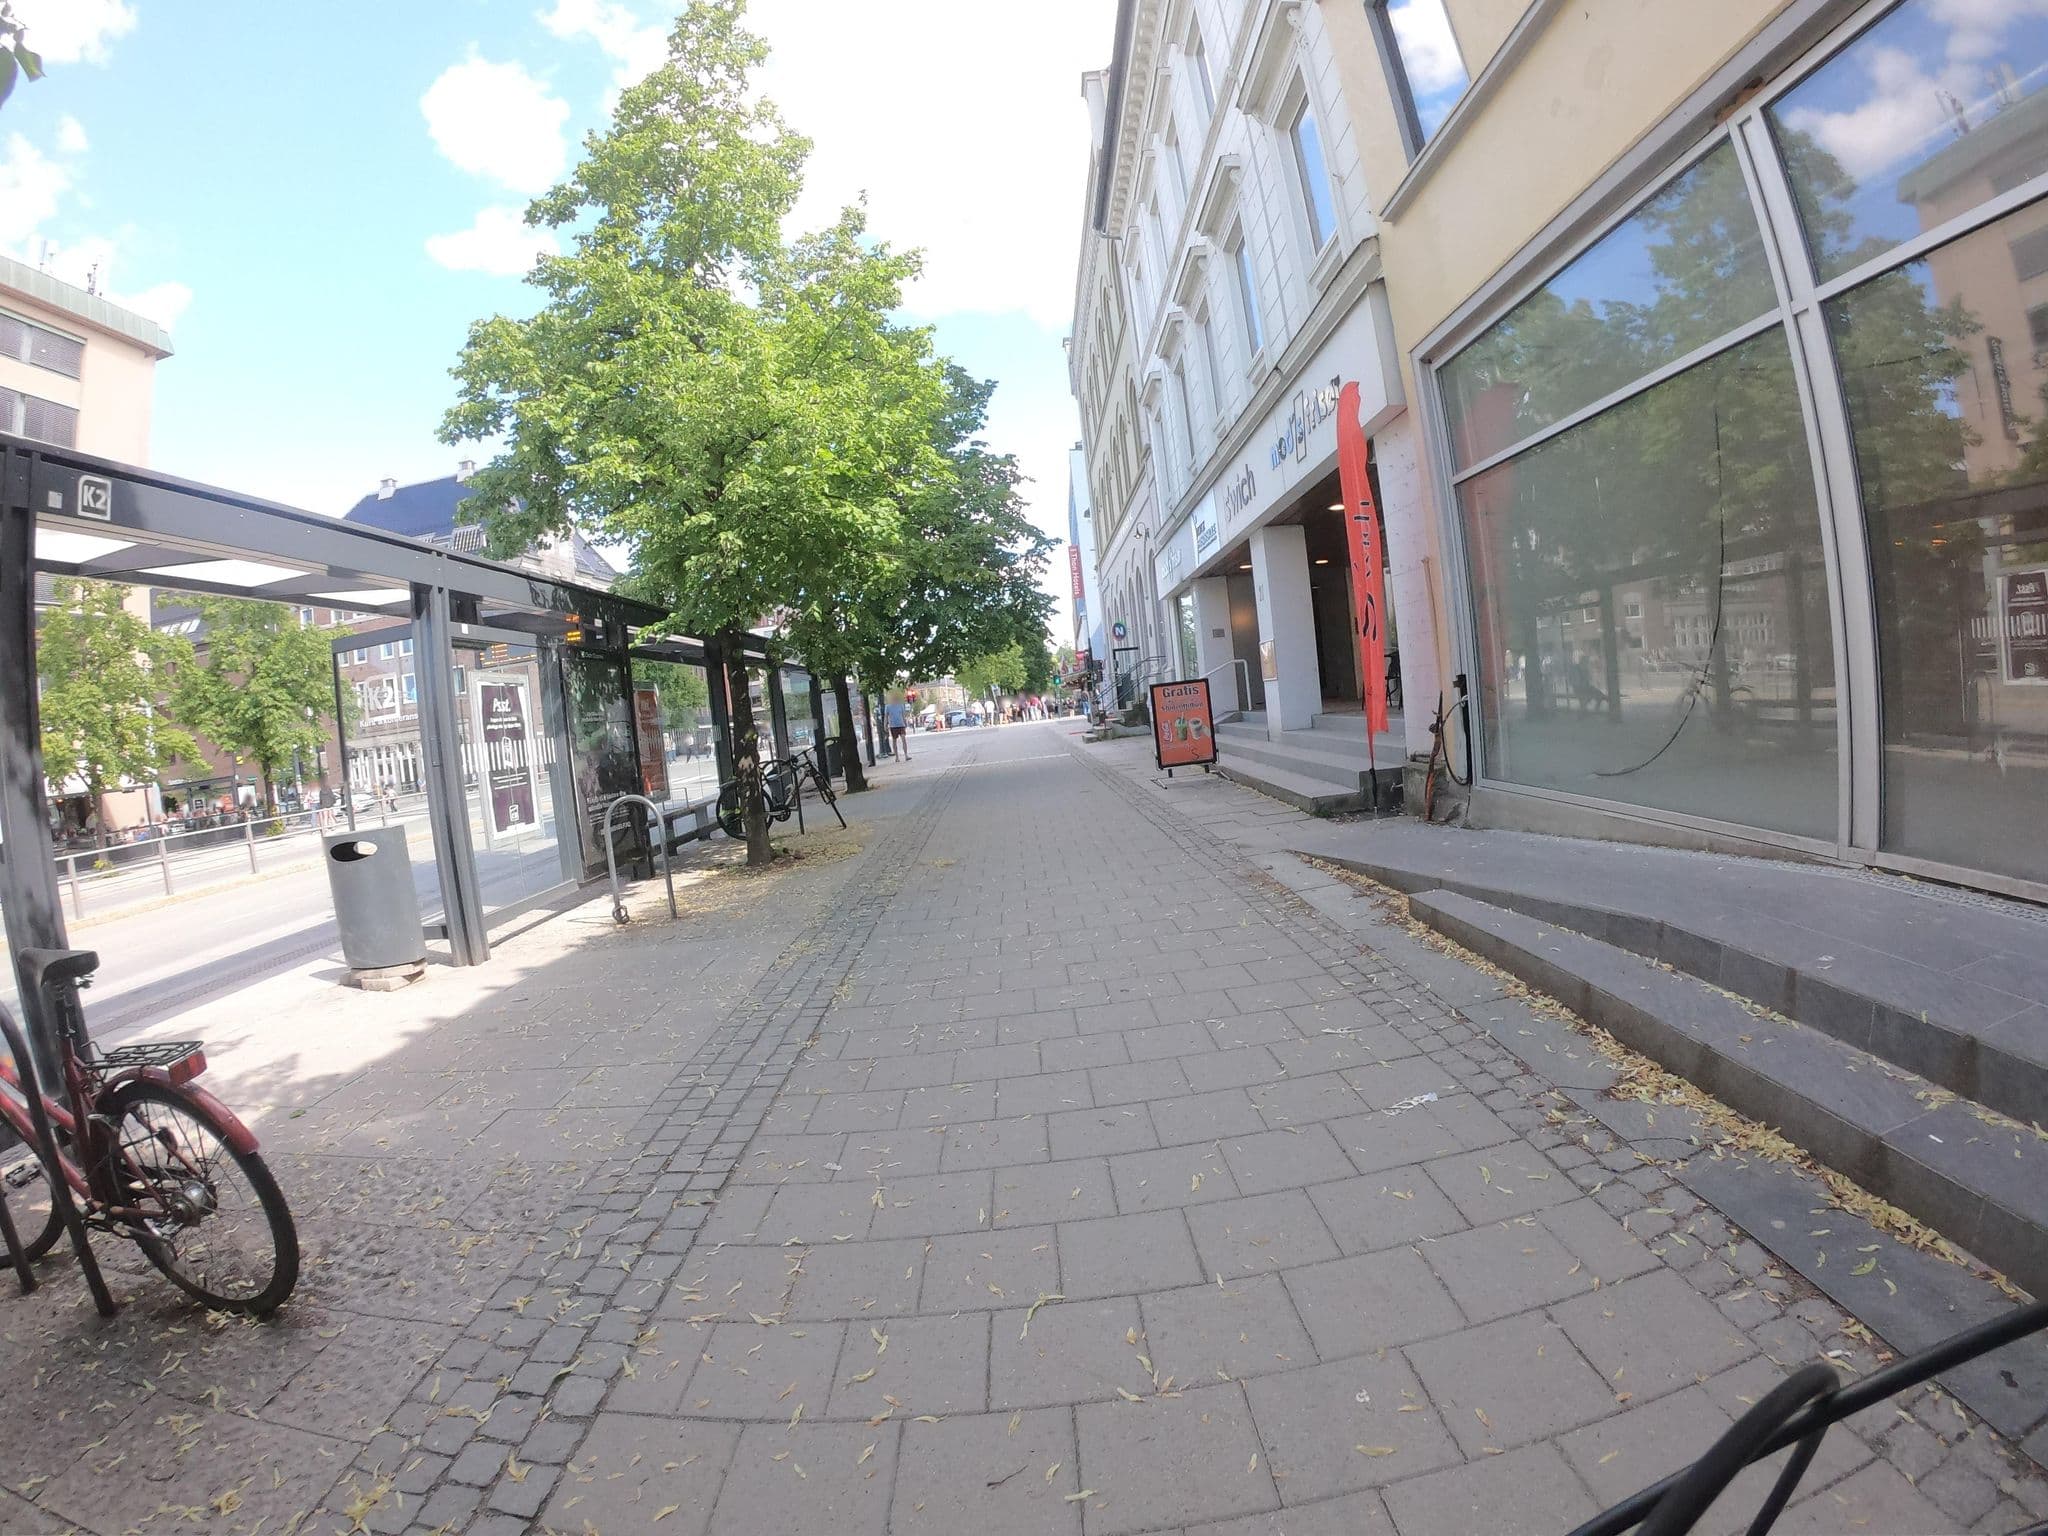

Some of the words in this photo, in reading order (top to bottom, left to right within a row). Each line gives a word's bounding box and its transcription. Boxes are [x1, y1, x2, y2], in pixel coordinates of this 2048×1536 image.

[83, 485, 107, 510] K2
[368, 686, 396, 711] K2
[1162, 685, 1199, 698] Gratis
